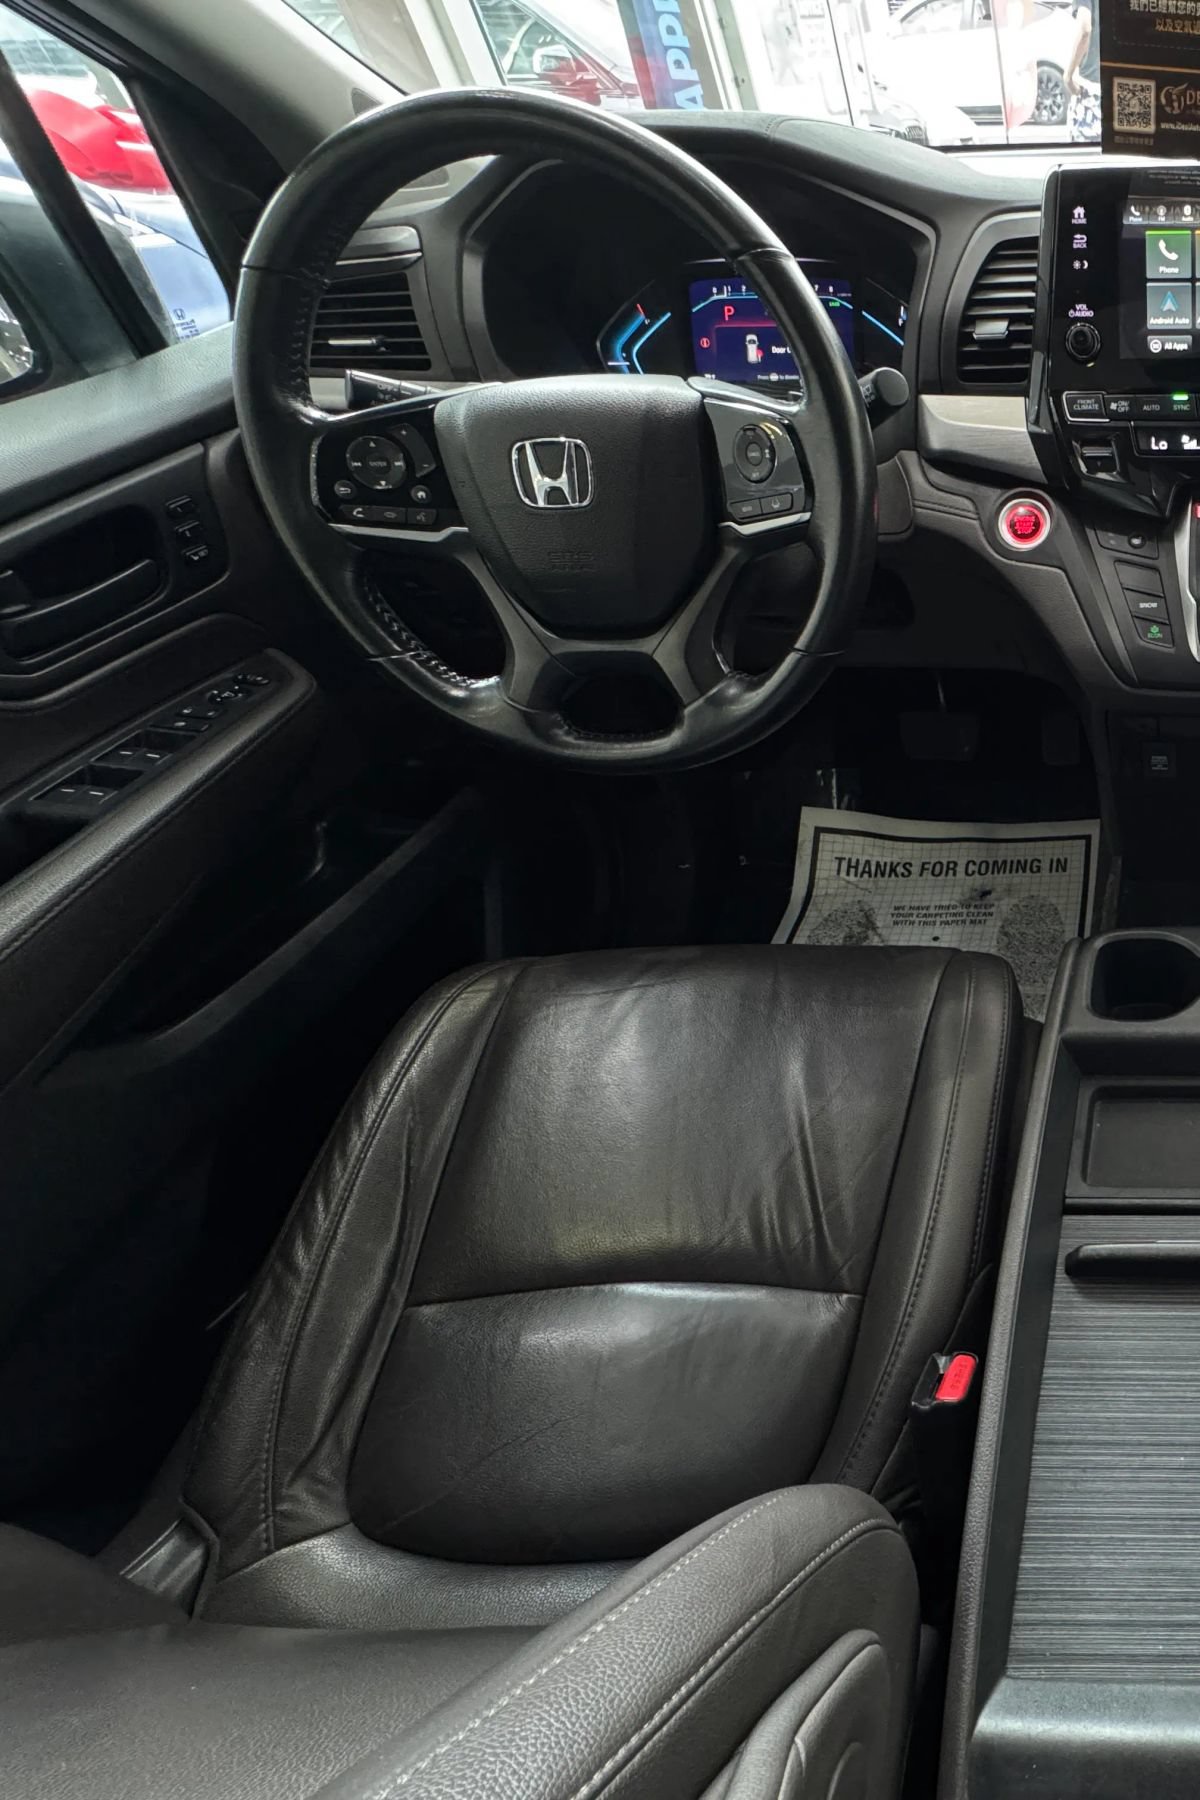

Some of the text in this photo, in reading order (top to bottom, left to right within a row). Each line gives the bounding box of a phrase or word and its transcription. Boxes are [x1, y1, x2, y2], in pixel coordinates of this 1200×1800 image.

[1159, 266, 1180, 274] Phone
[724, 305, 735, 321] P
[1150, 316, 1190, 325] Android Auto
[772, 346, 786, 354] Door
[1164, 341, 1189, 351] All Apps
[1151, 435, 1168, 450] Lo
[834, 857, 1068, 879] THANKS FOR COMING IN
